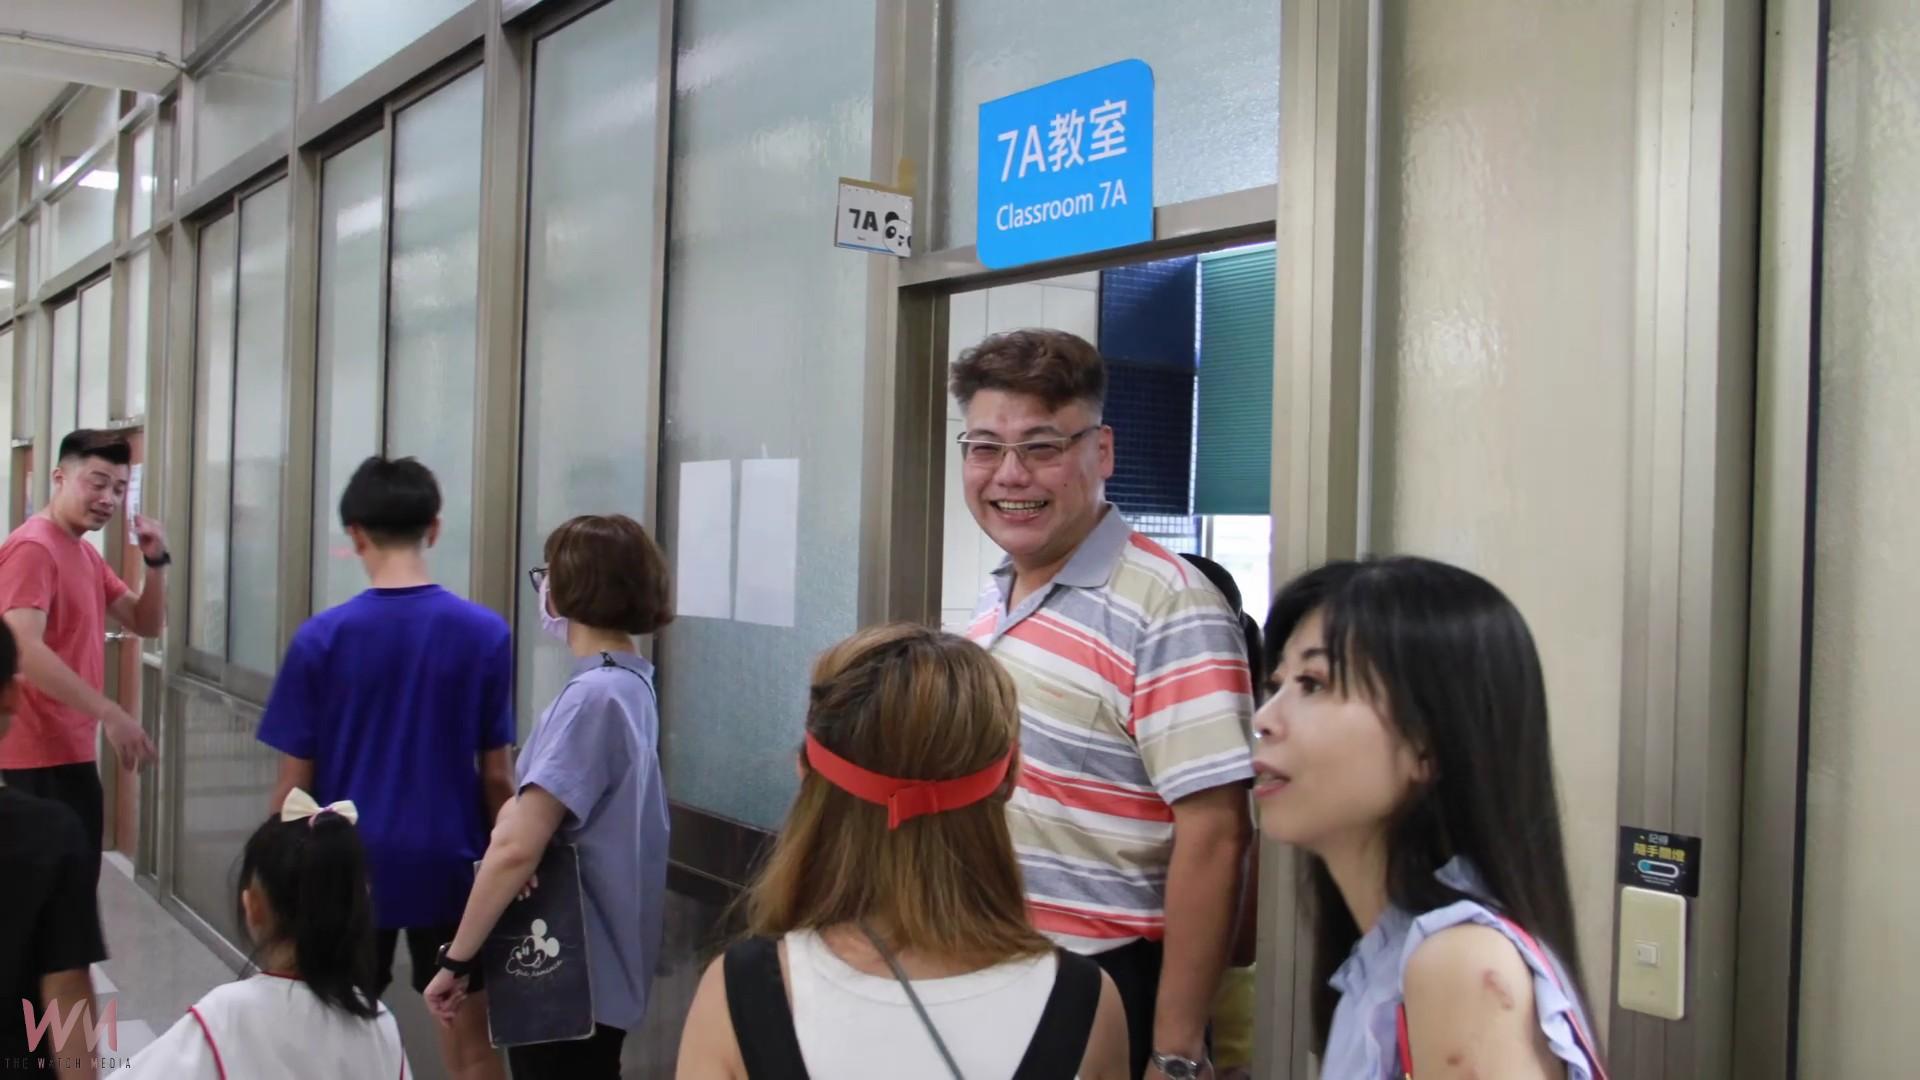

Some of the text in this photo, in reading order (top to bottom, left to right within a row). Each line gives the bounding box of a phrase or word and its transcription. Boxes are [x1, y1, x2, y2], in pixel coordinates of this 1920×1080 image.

[998, 99, 1127, 183] 7A教室
[849, 208, 878, 231] 7A
[996, 178, 1127, 231] Classroom 7A
